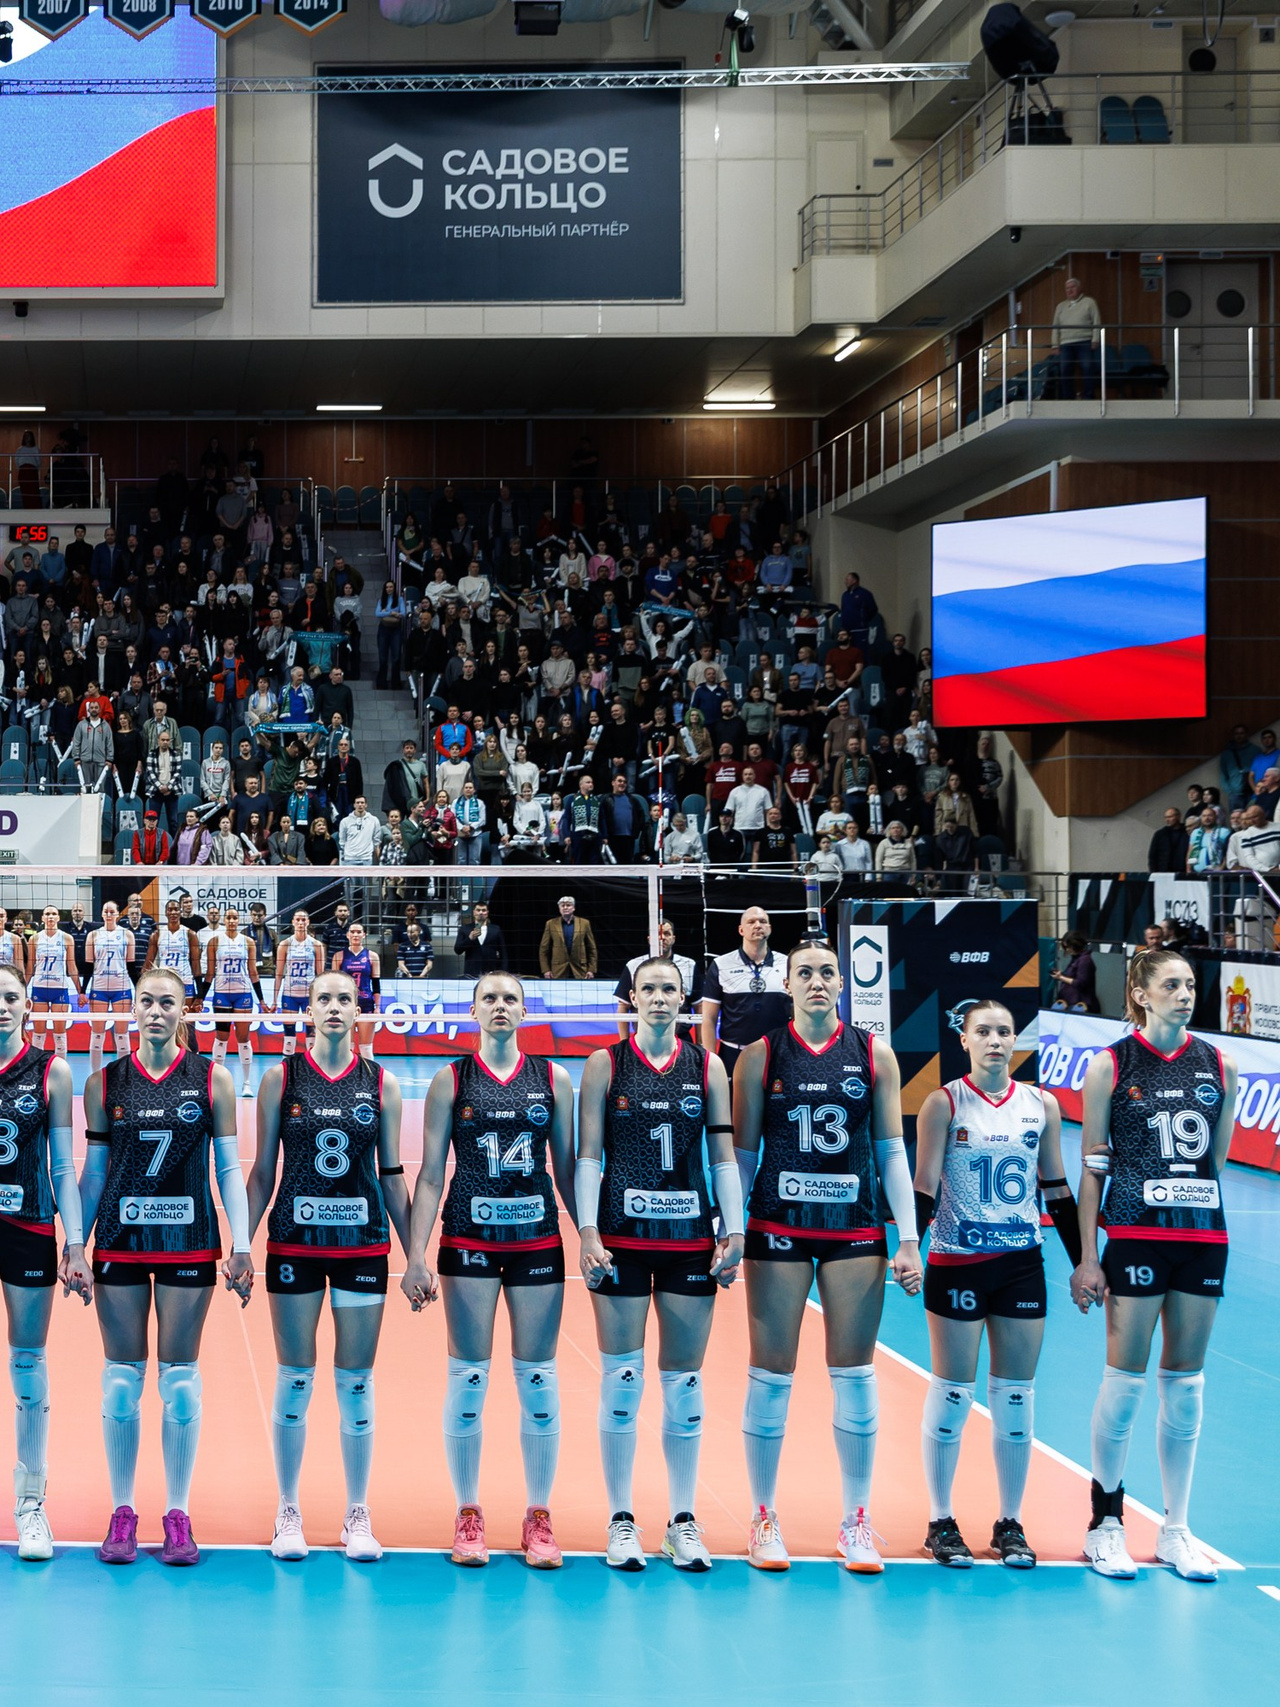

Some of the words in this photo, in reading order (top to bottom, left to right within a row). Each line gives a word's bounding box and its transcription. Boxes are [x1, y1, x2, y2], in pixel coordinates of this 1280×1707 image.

[37, 0, 70, 14] 2007
[123, 0, 156, 13] 2008
[443, 147, 629, 178] САДОВОЕ
[445, 182, 606, 212] КОЛЬЦО
[445, 222, 556, 238] ГЕНЕРАЛЬНЫЙ
[561, 220, 629, 236] ПАРТНЁР
[197, 888, 266, 900] САДОВОЕ
[43, 956, 57, 971] 17
[961, 952, 990, 963] ВФВ
[223, 958, 241, 974] 23
[291, 962, 309, 977] 22
[787, 1104, 849, 1154] 13
[1147, 1110, 1210, 1159] 19
[139, 1130, 172, 1176] 7
[315, 1129, 350, 1178] 8
[650, 1123, 673, 1170] 1
[477, 1132, 534, 1177] 14
[805, 1180, 854, 1189] САДОВОЕ
[970, 1156, 1028, 1204] 16
[805, 1189, 848, 1197] КОЛЬЦО
[1172, 1185, 1214, 1194] САДОВОЕ
[1173, 1194, 1210, 1203] КОЛЬЦО
[144, 1203, 189, 1211] САДОВОЕ
[318, 1204, 363, 1212] САДОВОЕ
[496, 1202, 540, 1212] САДОВОЕ
[651, 1206, 690, 1214] КОЛЬЦО
[144, 1211, 184, 1219] КОЛЬЦО
[497, 1210, 536, 1219] КОЛЬЦО
[763, 1232, 792, 1250] 13
[987, 1231, 1031, 1239] САДОВОЕ
[987, 1239, 1028, 1247] КОЛЬЦО
[279, 1264, 295, 1283] 8
[529, 1266, 553, 1274] ZEDO
[1125, 1266, 1154, 1285] 19
[947, 1289, 977, 1310] 16
